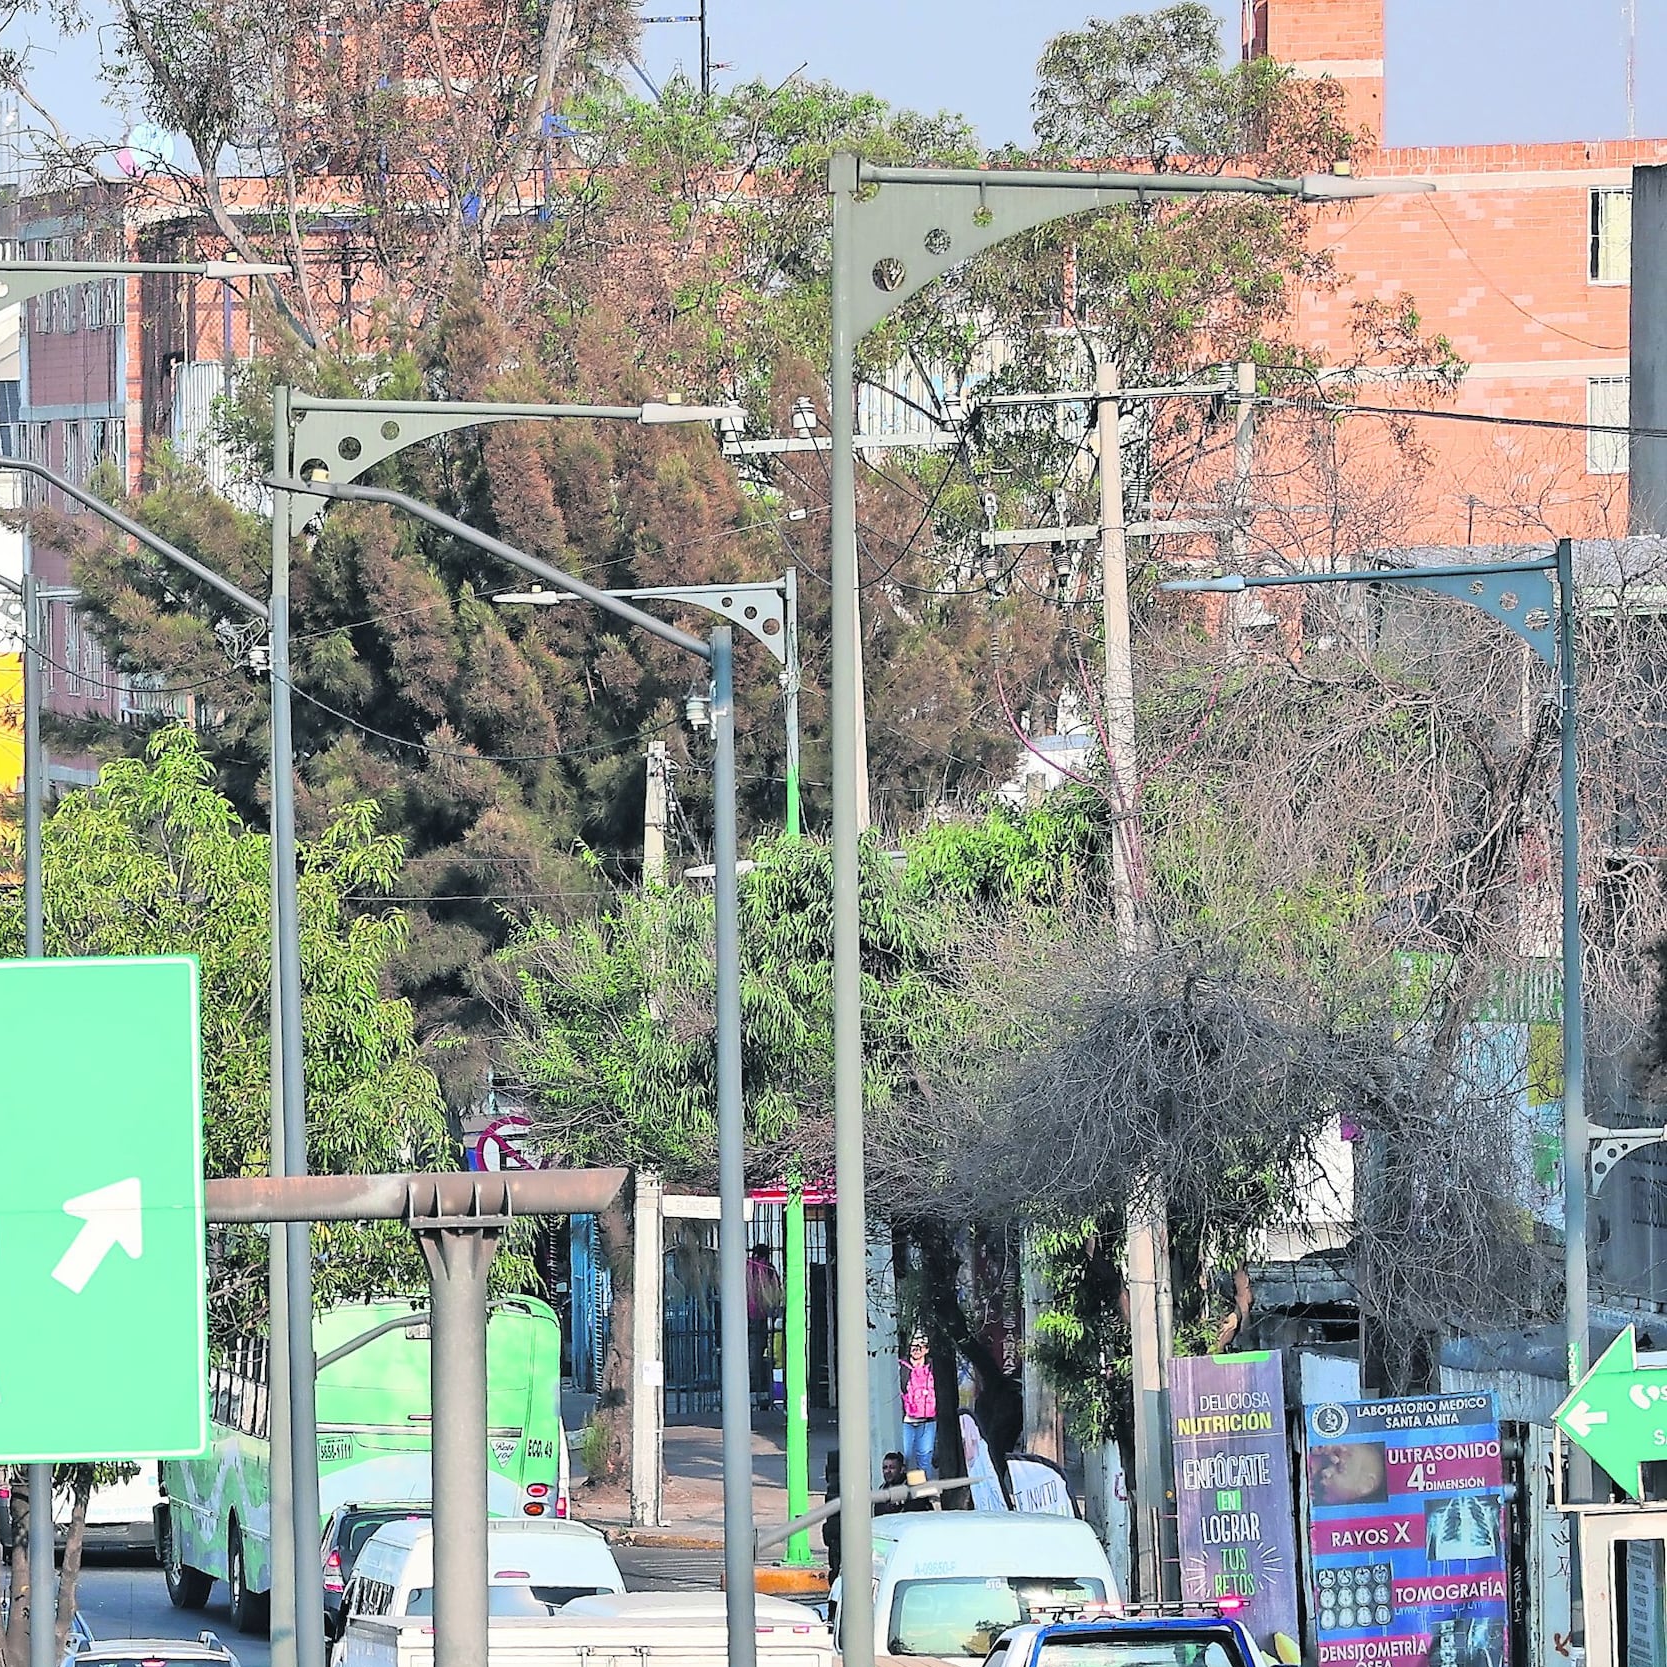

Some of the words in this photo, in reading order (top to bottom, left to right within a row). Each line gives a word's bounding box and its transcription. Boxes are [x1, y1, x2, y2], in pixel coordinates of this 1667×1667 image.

[1199, 1391, 1272, 1413] DELICIOSA
[1356, 1401, 1437, 1418] LABORATORIO
[1438, 1397, 1487, 1411] MEDICO
[1177, 1411, 1273, 1436] NUTRICIÓN
[1385, 1416, 1424, 1429] SANTA
[1425, 1413, 1460, 1427] ANITA
[1388, 1441, 1501, 1465] ULTRASONIDO
[1183, 1451, 1272, 1491] ENFÓCATE
[1425, 1476, 1485, 1491] DIMENSIÓN
[1220, 1493, 1237, 1511] EN
[1201, 1513, 1261, 1544] LOGRAR
[1331, 1528, 1390, 1548] RAYOS
[1392, 1520, 1411, 1545] X
[1220, 1548, 1247, 1572] TUS
[1214, 1573, 1256, 1598] RETOS
[1395, 1576, 1505, 1604] TOMOGRAFÍA
